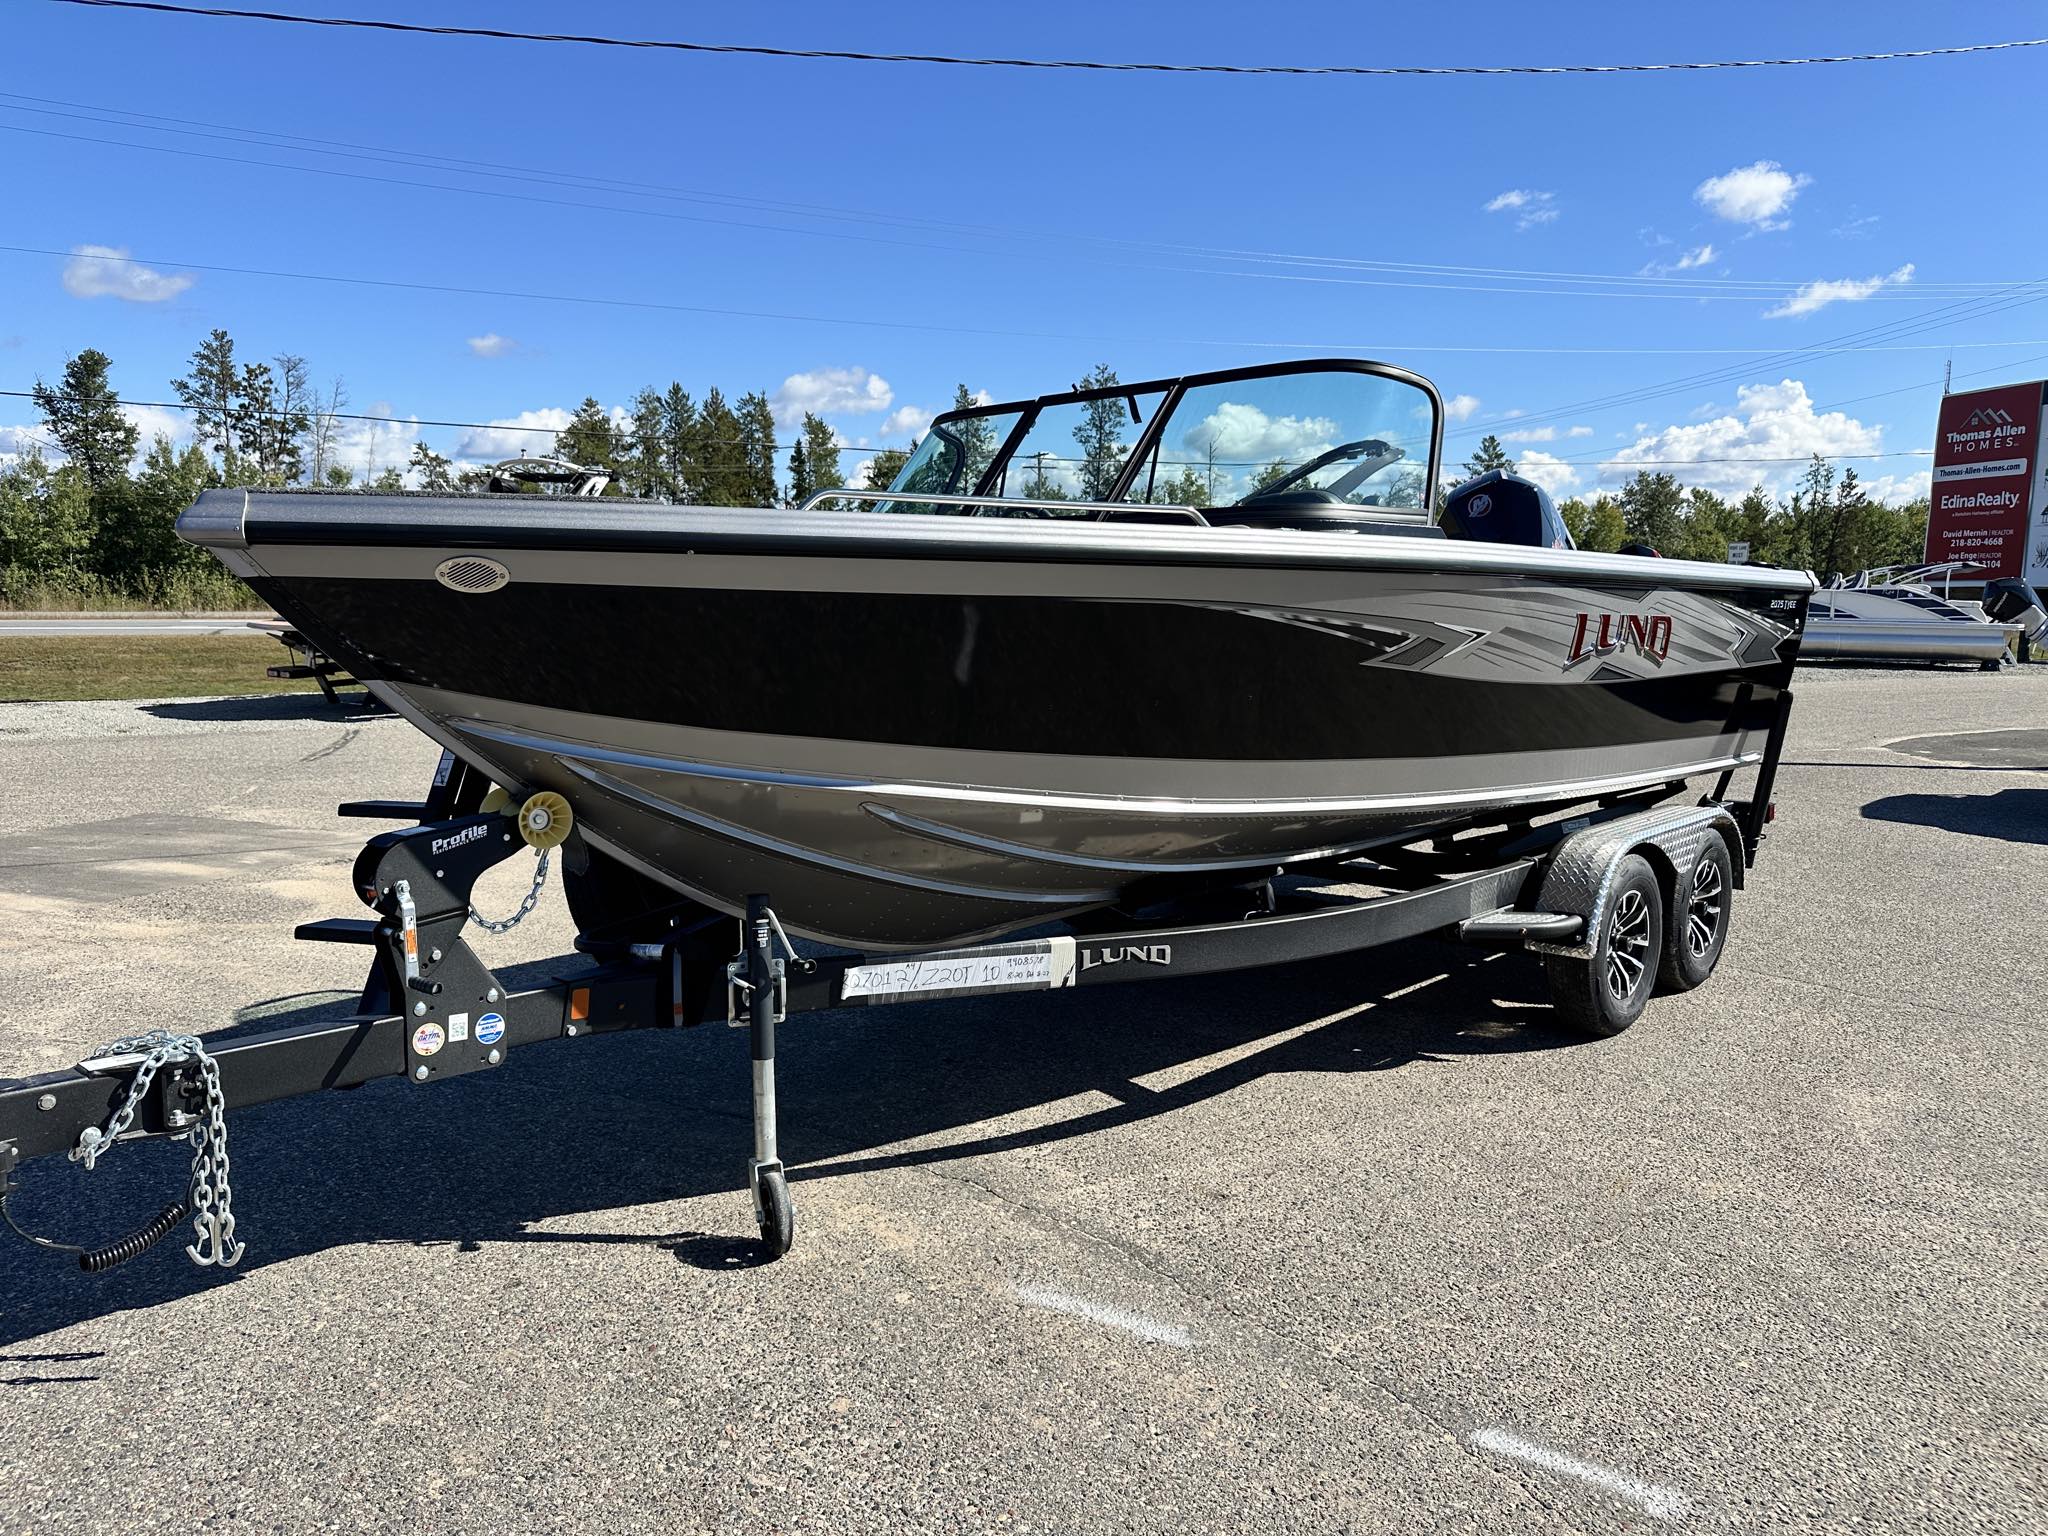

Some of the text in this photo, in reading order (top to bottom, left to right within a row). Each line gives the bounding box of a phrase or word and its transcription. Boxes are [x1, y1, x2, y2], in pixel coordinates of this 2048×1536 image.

[1946, 425, 2026, 443] Thomas Allen
[1954, 437, 2013, 453] HOMES
[1939, 463, 2021, 477] Thomas-Allen-Homes.com
[1943, 530, 1962, 538] David
[1963, 529, 1988, 537] Mernin
[1951, 537, 2003, 547] 218-820-4668
[1947, 552, 1959, 560] Joe
[1960, 551, 1978, 560] Enge
[1562, 612, 1672, 673] LUND
[432, 824, 488, 852] Profile
[1080, 945, 1171, 971] LUND
